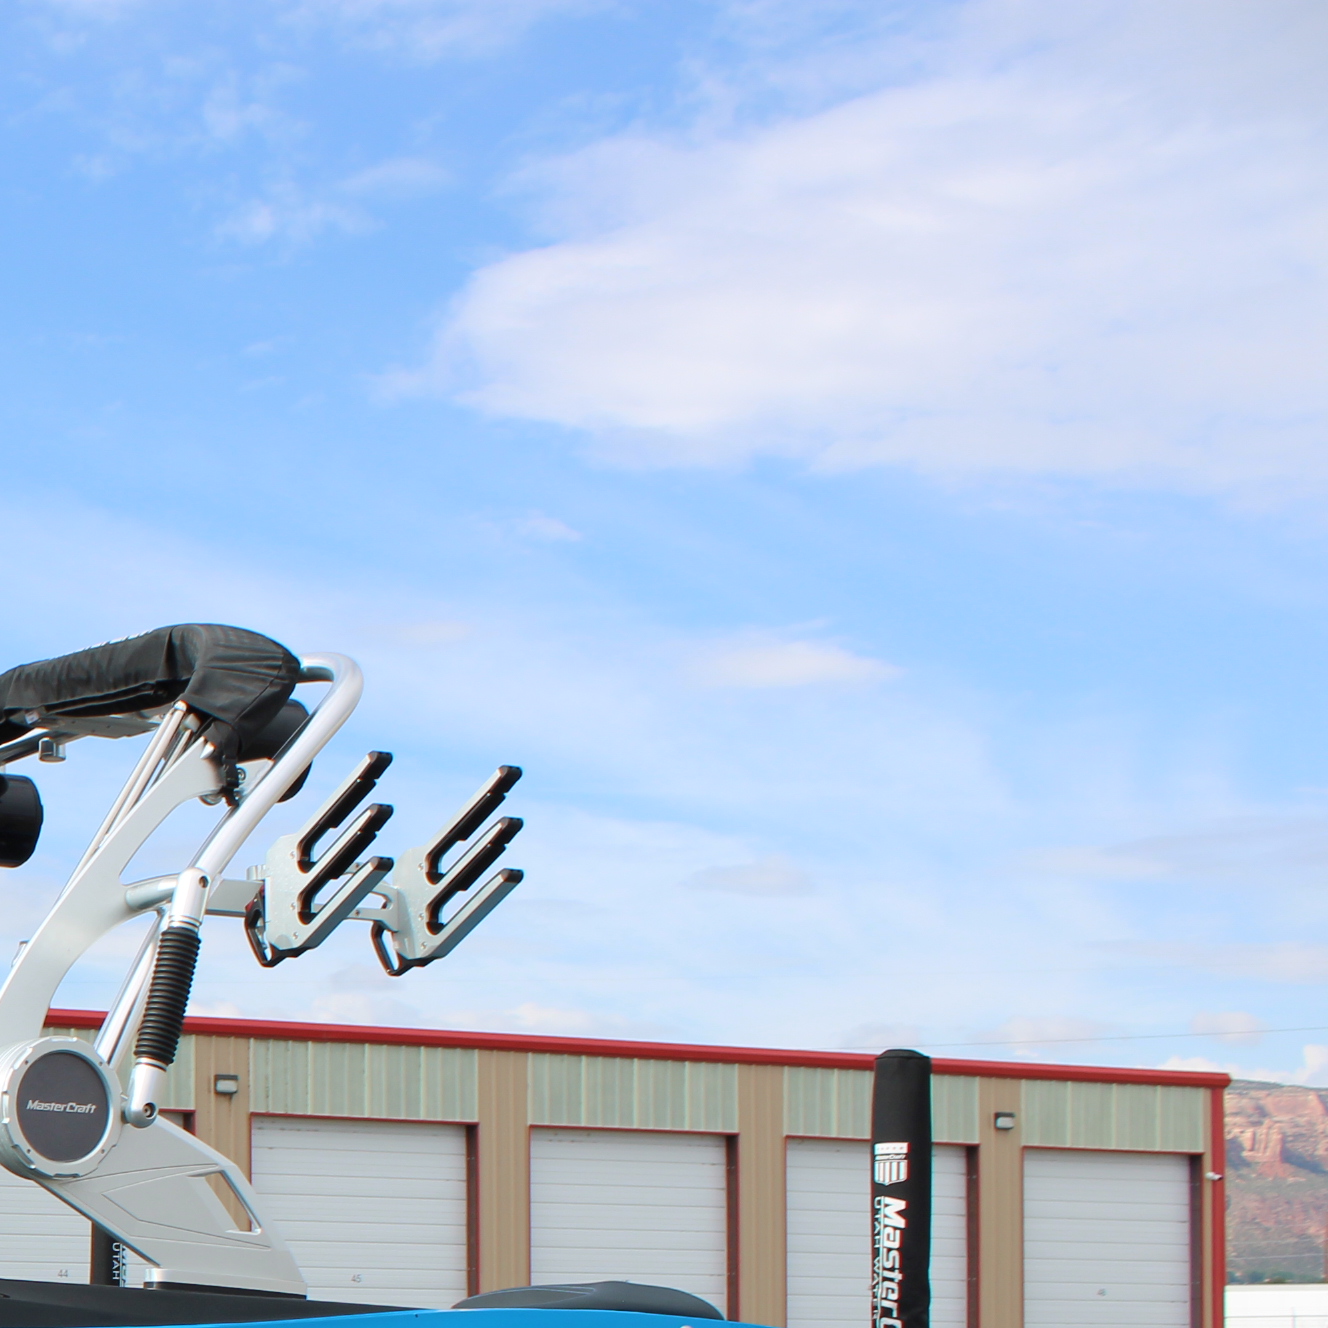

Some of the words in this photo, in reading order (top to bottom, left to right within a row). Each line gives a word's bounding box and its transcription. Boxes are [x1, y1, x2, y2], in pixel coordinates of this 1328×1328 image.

[26, 1099, 96, 1114] MasterCraft
[112, 1242, 120, 1280] UTAH
[57, 1269, 69, 1278] 44
